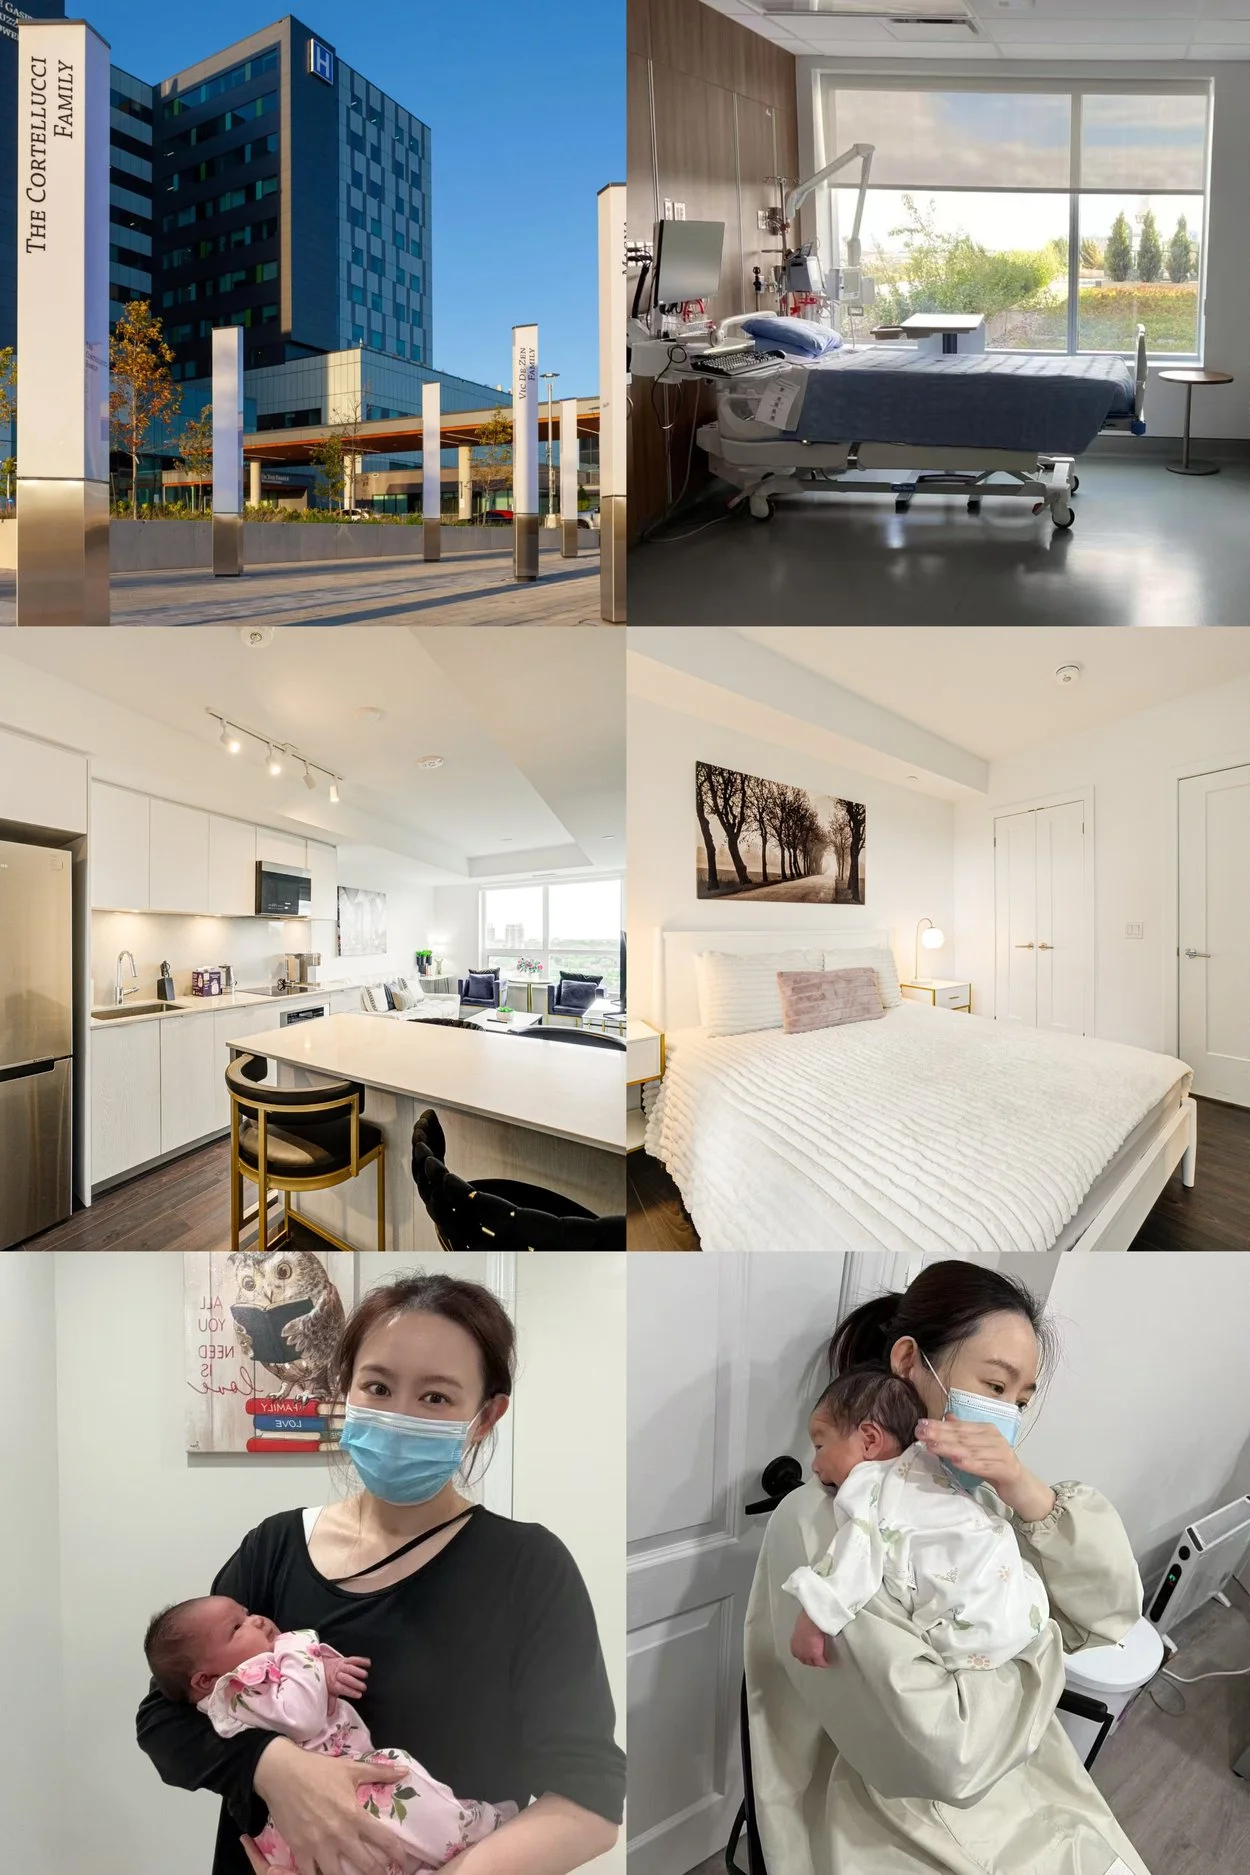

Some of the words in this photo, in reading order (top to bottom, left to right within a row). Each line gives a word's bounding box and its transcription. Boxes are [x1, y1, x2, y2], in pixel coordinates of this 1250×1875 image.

[317, 45, 330, 79] H
[26, 55, 47, 203] CORTELLUCCI
[54, 60, 73, 139] FAMILY
[26, 210, 46, 254] THE
